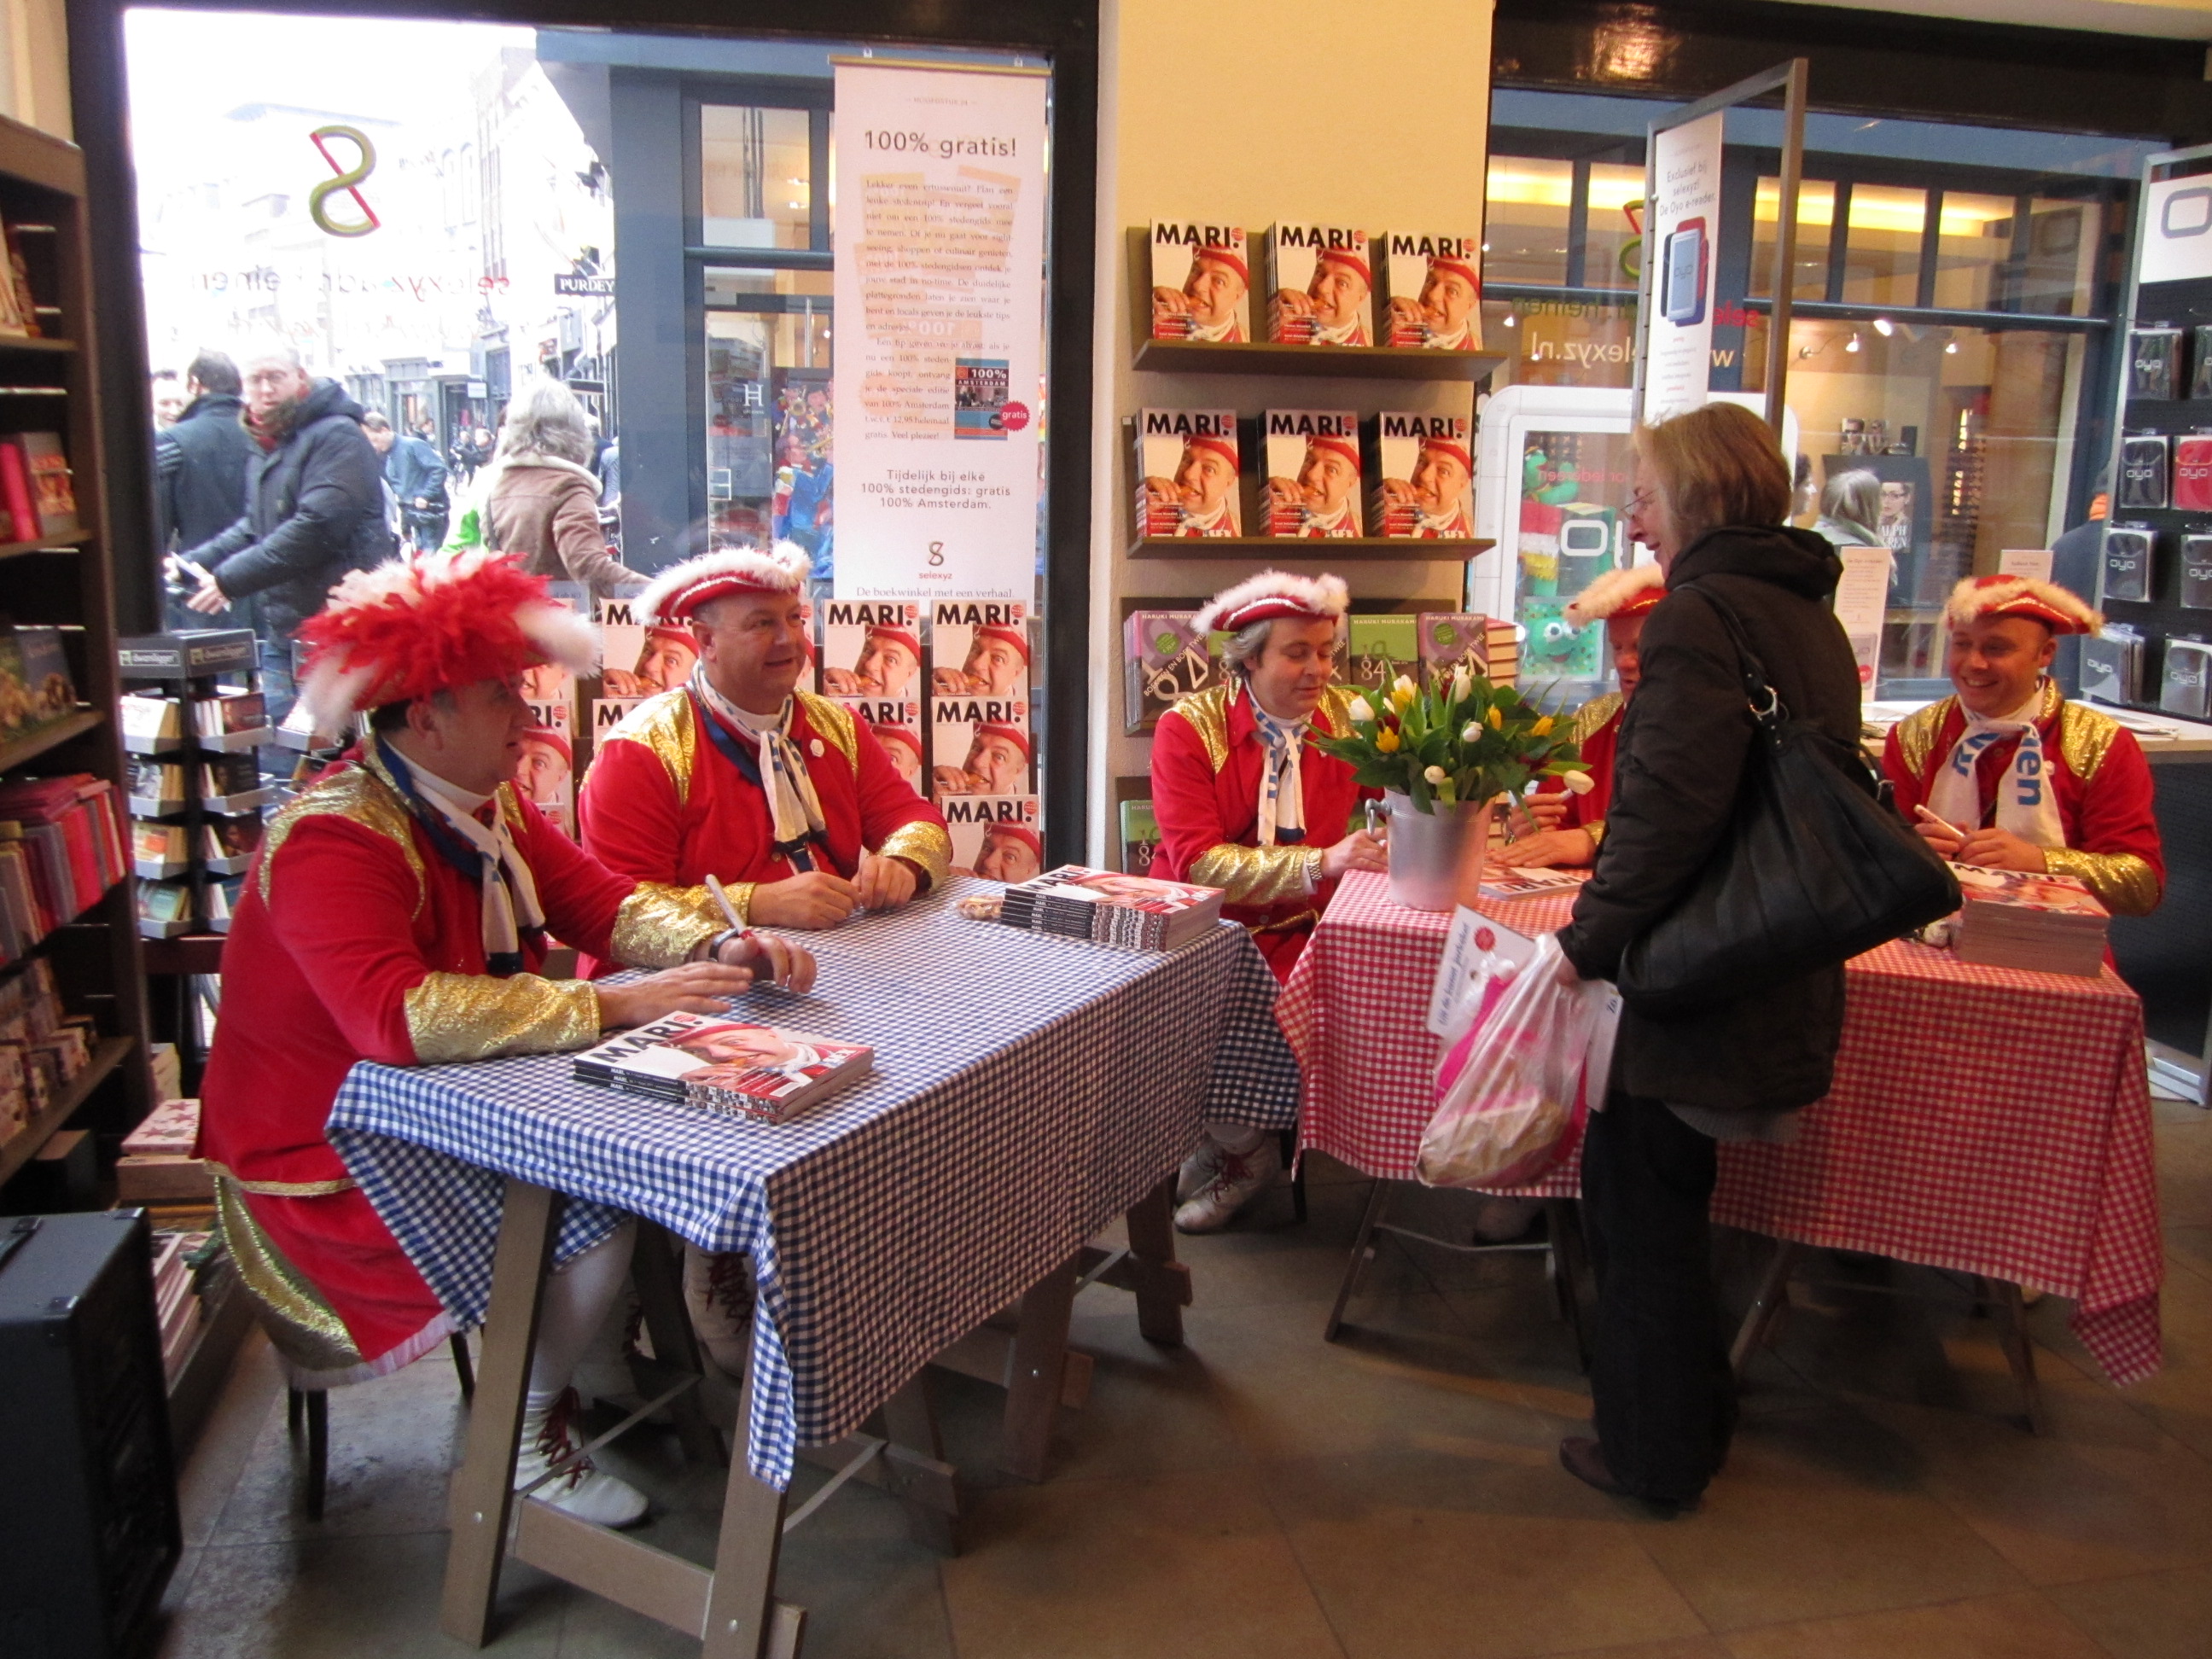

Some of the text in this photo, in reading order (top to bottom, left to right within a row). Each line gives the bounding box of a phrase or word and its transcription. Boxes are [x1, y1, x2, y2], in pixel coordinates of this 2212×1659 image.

[865, 131, 1016, 159] 100% gratis!
[1668, 162, 1696, 182] Exclusief
[866, 180, 894, 189] Lekker
[1660, 204, 1668, 216] De
[1670, 201, 1683, 214] Oyo
[949, 217, 991, 226] stedengids
[950, 232, 966, 241] gaat
[1155, 224, 1239, 248] MARI.
[1281, 226, 1361, 251] MARI.
[898, 246, 931, 254] shoppen
[1392, 236, 1470, 259] MARI.
[866, 306, 882, 315] bent
[898, 307, 918, 316] locals
[921, 310, 943, 318] geven
[946, 309, 953, 318] je
[955, 309, 964, 317] de
[967, 310, 994, 319] leukste
[996, 311, 1010, 320] tips
[896, 338, 906, 348] tip
[910, 340, 933, 349] geven
[989, 341, 1000, 350] als
[1003, 342, 1010, 352] je
[865, 370, 882, 378] gids
[918, 372, 951, 381] ontvang
[972, 369, 1006, 378] 100%
[892, 386, 923, 395] speciale
[904, 401, 950, 410] Amsterdam
[914, 416, 949, 425] helemaal
[1002, 411, 1027, 420] gratis
[1147, 413, 1230, 435] MARI.
[1270, 415, 1351, 437] MARI.
[1384, 416, 1462, 439] MARI.
[911, 432, 940, 442] plezier!
[887, 469, 985, 482] Tijdelijk bij elke
[2126, 469, 2153, 480] oyo
[2180, 468, 2208, 479] oyo
[861, 483, 1010, 498] 100% stedengids: gratis
[881, 498, 991, 509] 100% Amsterdam.
[2110, 559, 2136, 570] oyo
[919, 572, 952, 581] selexyz
[857, 587, 870, 597] De
[874, 587, 931, 597] boekwinkel
[935, 589, 952, 597] met
[976, 589, 1014, 598] verhaal.
[829, 604, 912, 626] MARI.
[937, 604, 1019, 626] MARI.
[2087, 659, 2113, 672] oyo
[859, 702, 913, 724] ARI.
[937, 701, 1021, 723] MARI.
[947, 800, 1032, 823] MARI.
[589, 1021, 703, 1063] MARI.
